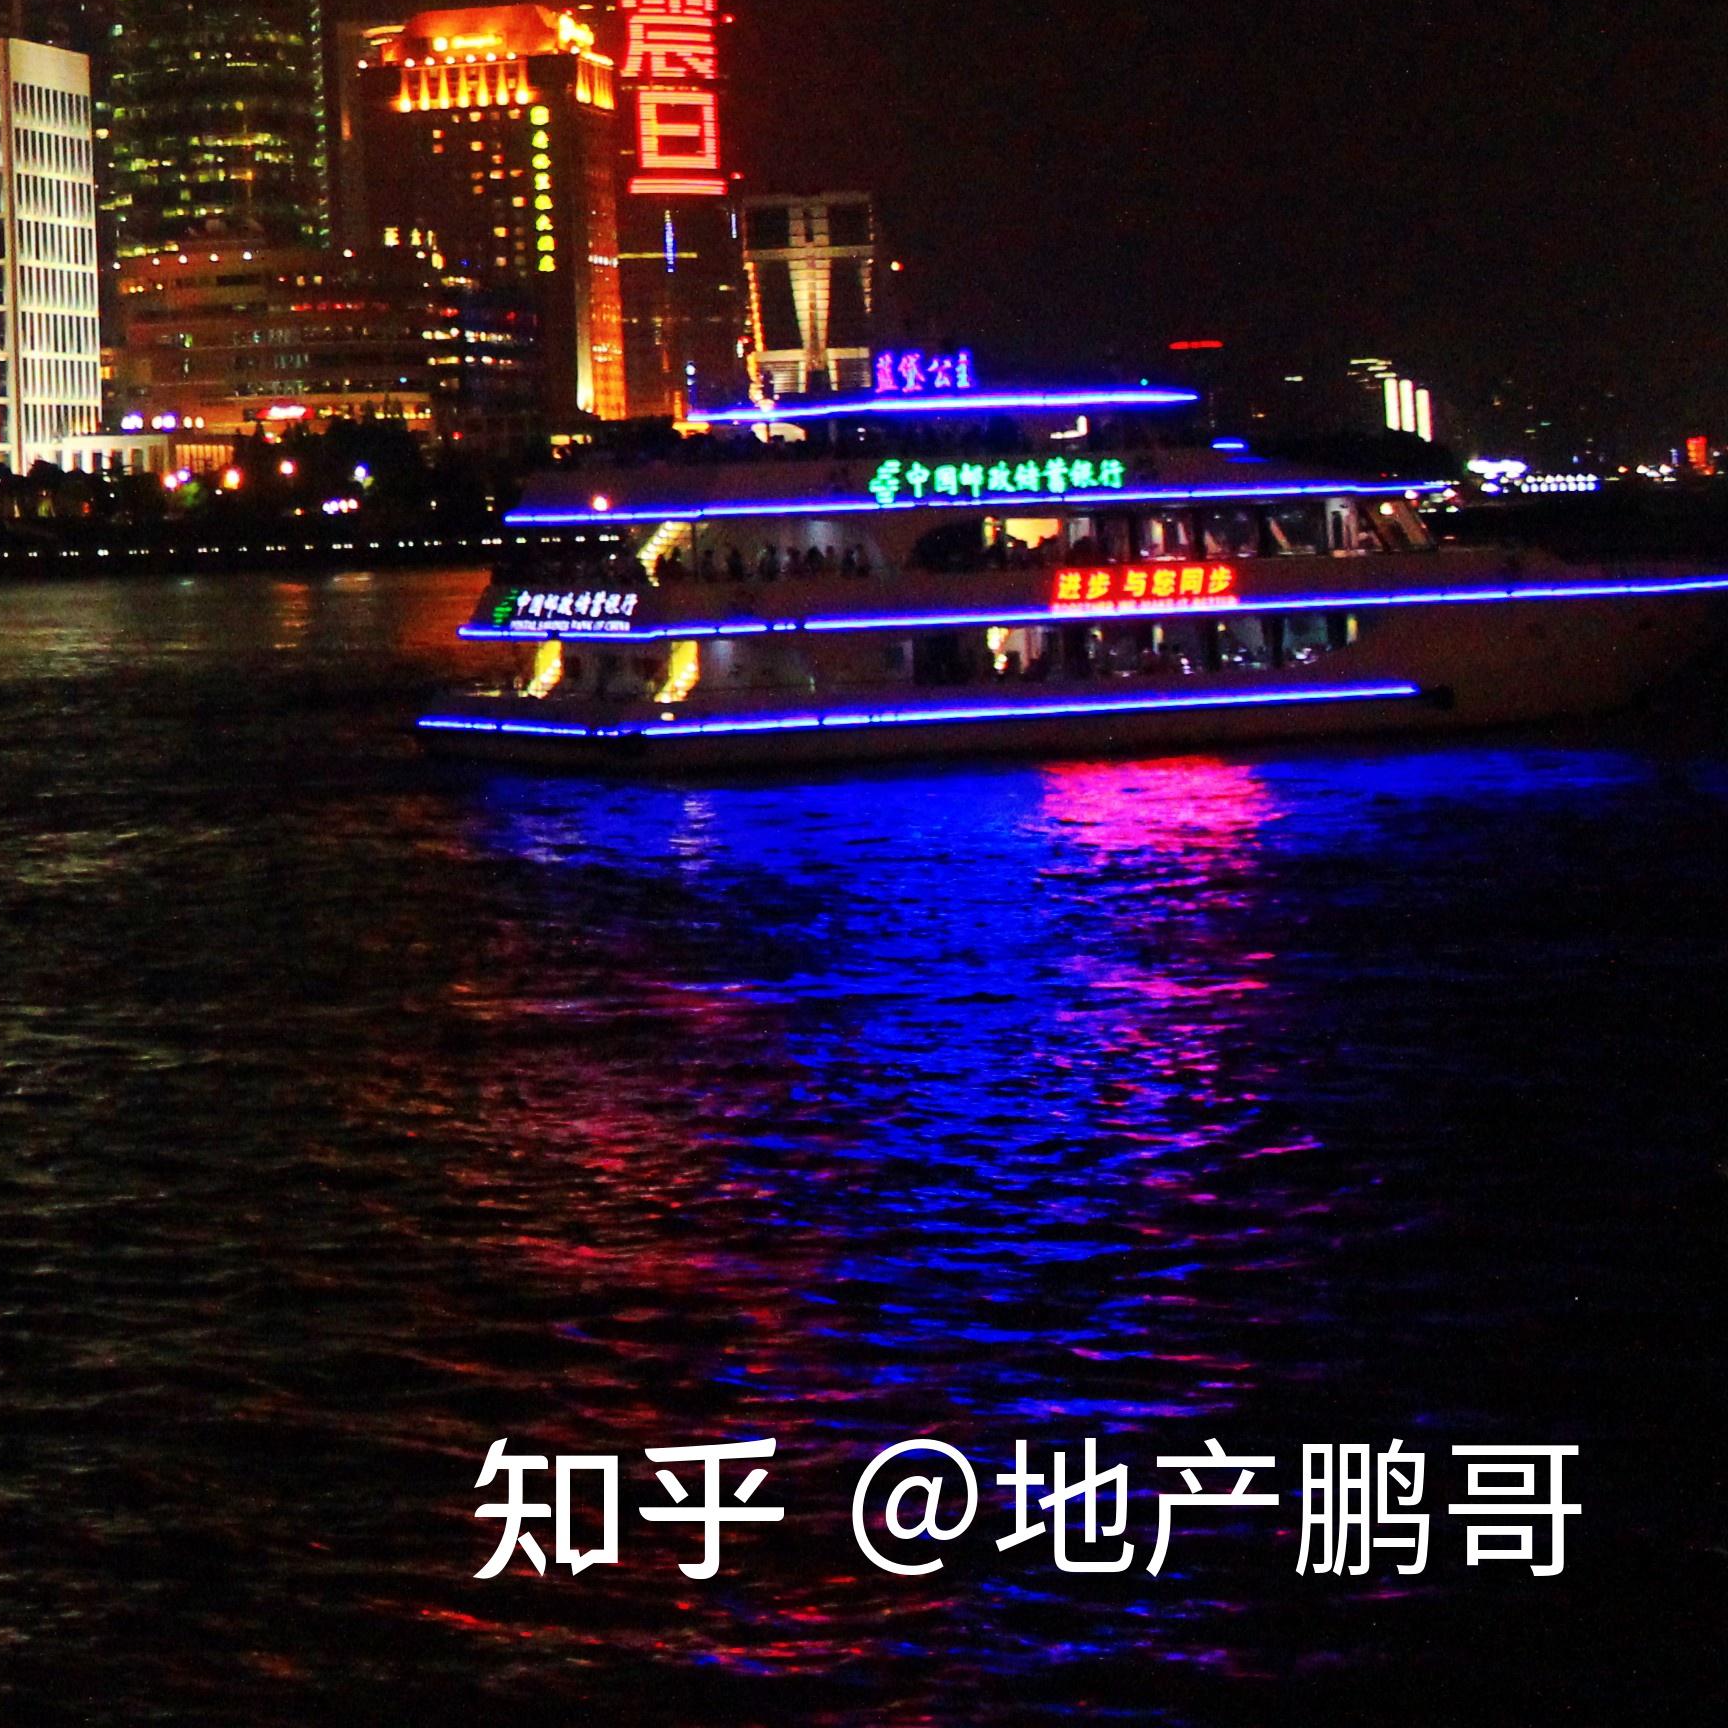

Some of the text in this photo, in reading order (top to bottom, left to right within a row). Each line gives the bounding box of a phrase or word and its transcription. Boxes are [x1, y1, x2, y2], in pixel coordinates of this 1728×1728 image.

[905, 456, 1124, 499] 中国邮政储蓄银行
[1058, 566, 1233, 599] 进步 与您同步
[516, 590, 638, 619] 中国邮政储蓄银行
